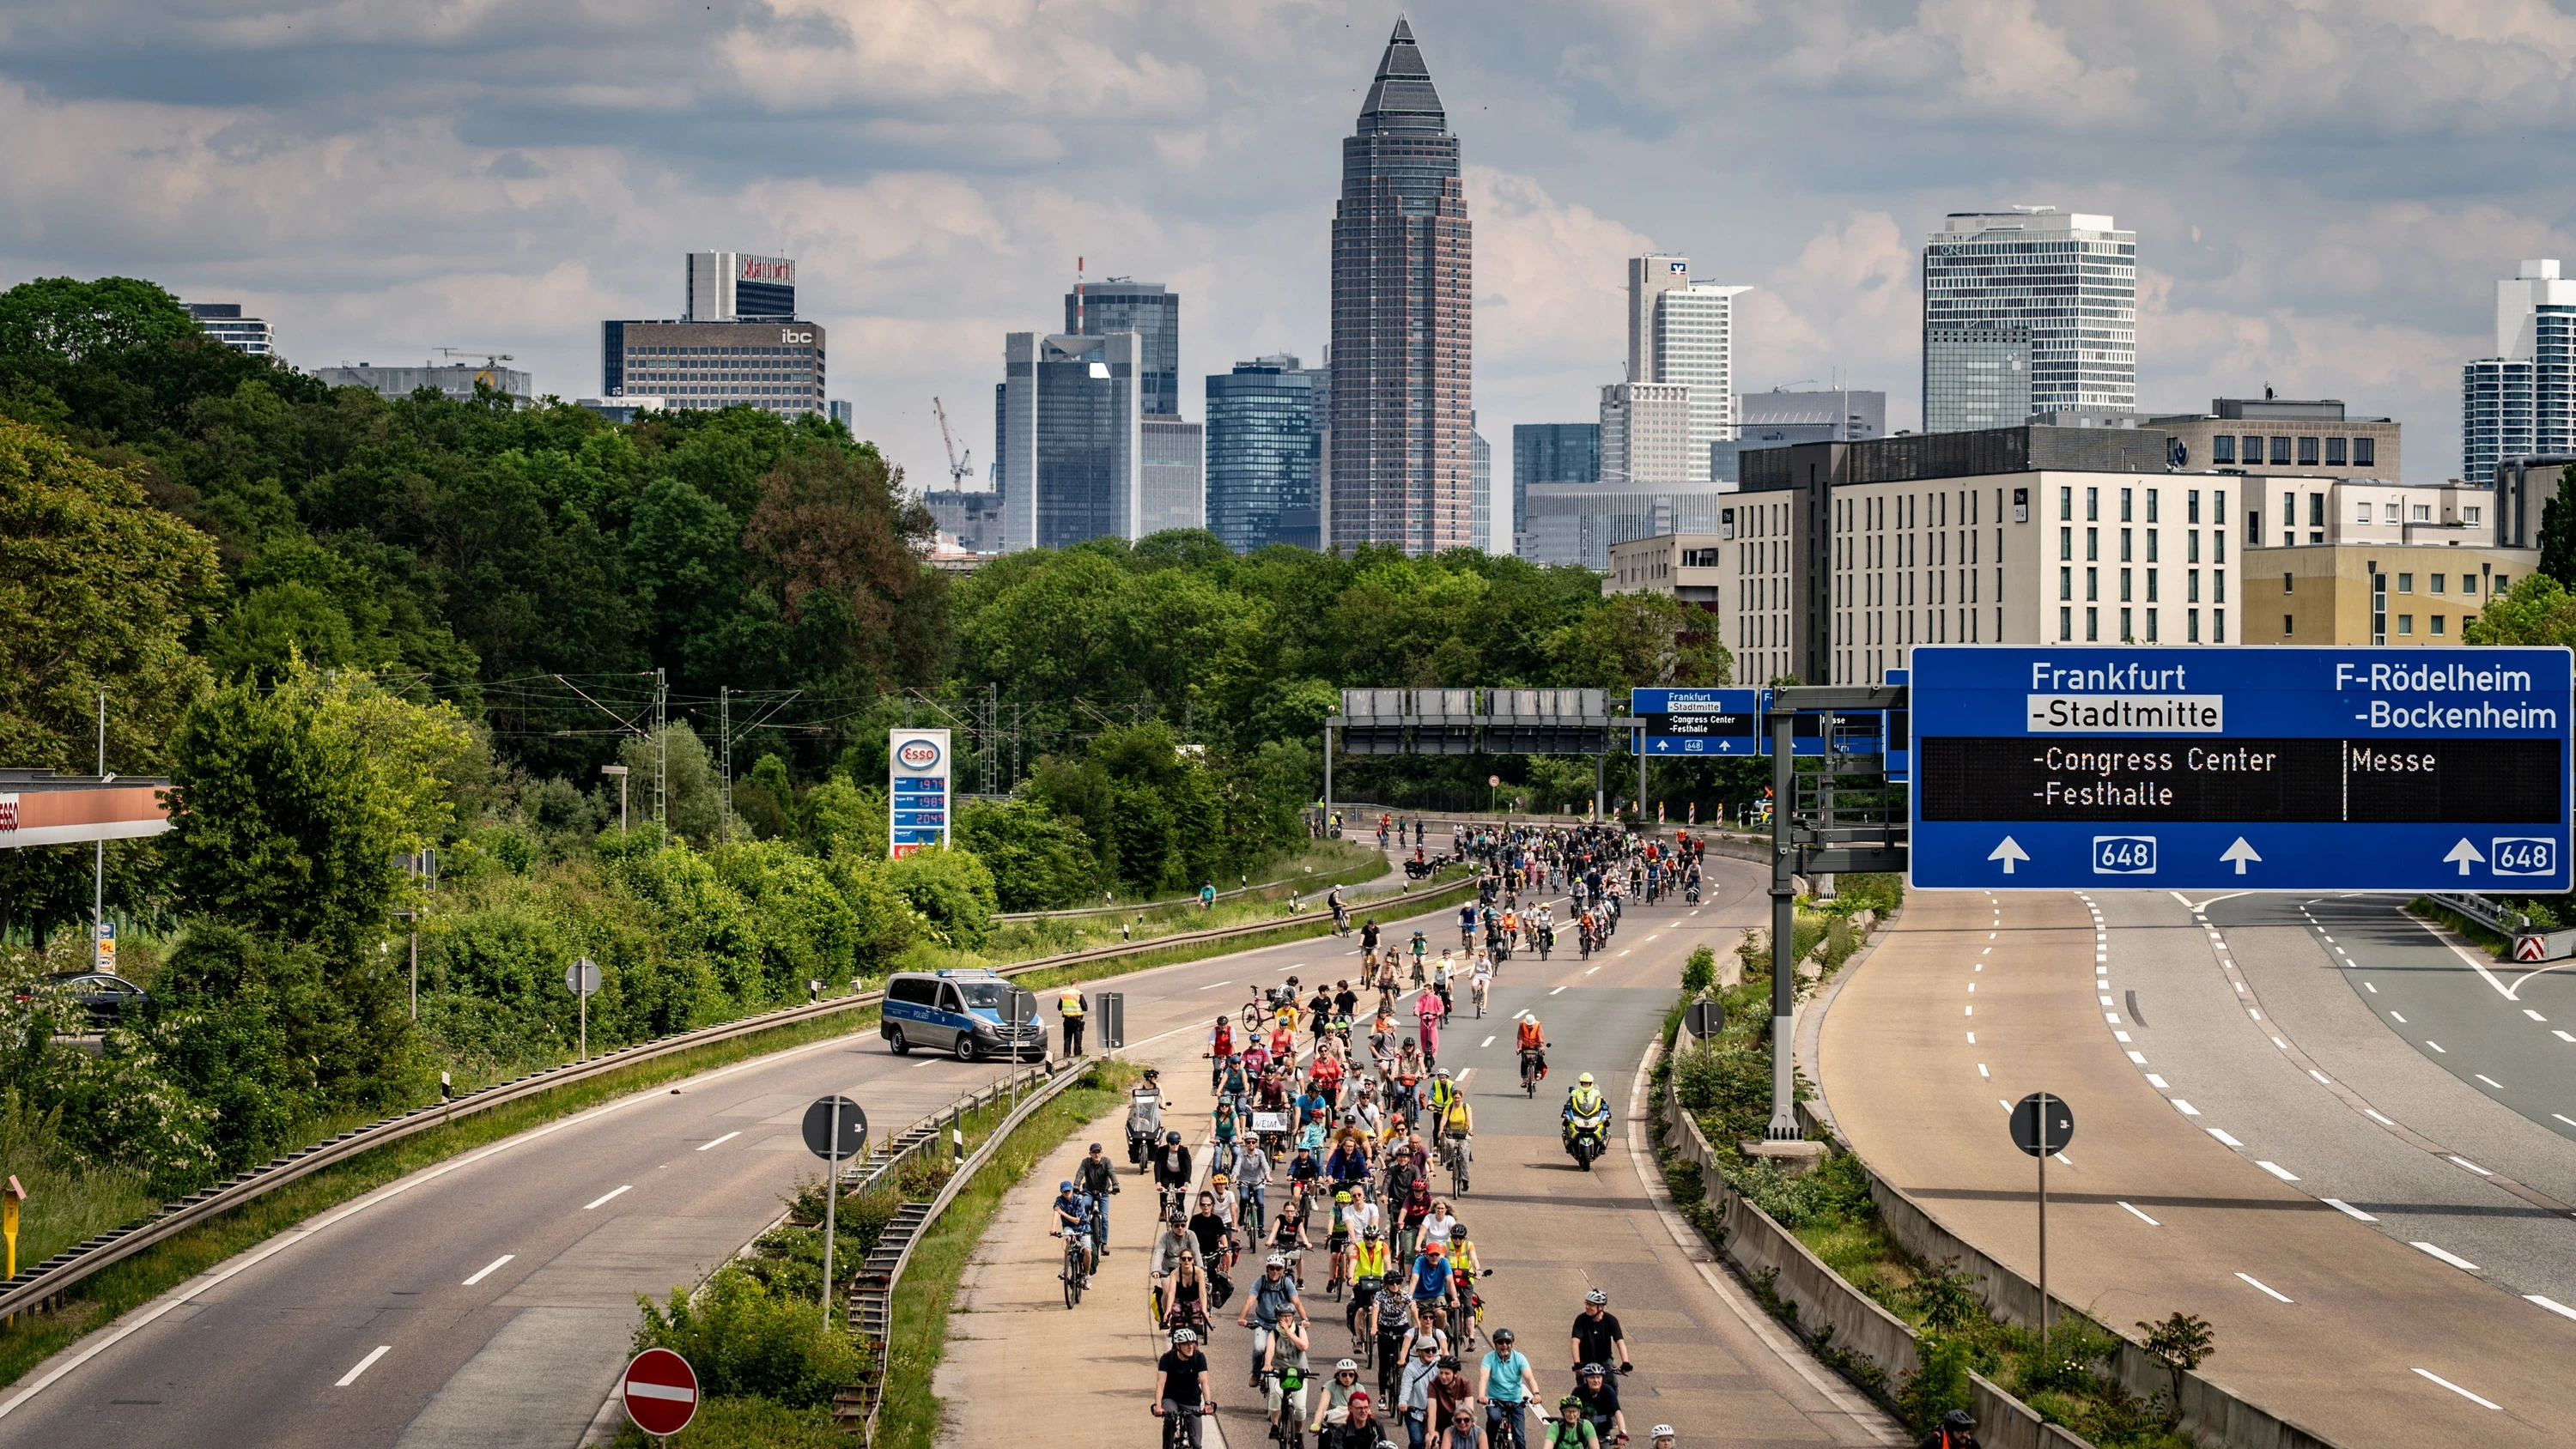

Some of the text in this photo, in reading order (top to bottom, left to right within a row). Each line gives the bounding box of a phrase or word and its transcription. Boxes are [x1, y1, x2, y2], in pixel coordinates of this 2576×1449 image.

[1941, 245, 1962, 256] ONE
[782, 329, 812, 343] ibc
[2032, 663, 2185, 690] Frankfurt
[2336, 664, 2530, 691] F-Rödelheim
[1668, 692, 1710, 701] Frankfurt
[1669, 715, 1735, 724] -Congress Center
[2033, 700, 2217, 726] -Stadtmitte
[2355, 700, 2556, 728] -Bockenheim
[2033, 747, 2276, 776] -Congress Center
[2353, 748, 2436, 771] Messe
[2033, 782, 2173, 805] -Festhalle
[2101, 844, 2148, 866] 648
[2500, 846, 2548, 867] 648
[913, 1010, 930, 1019] POLIZEI
